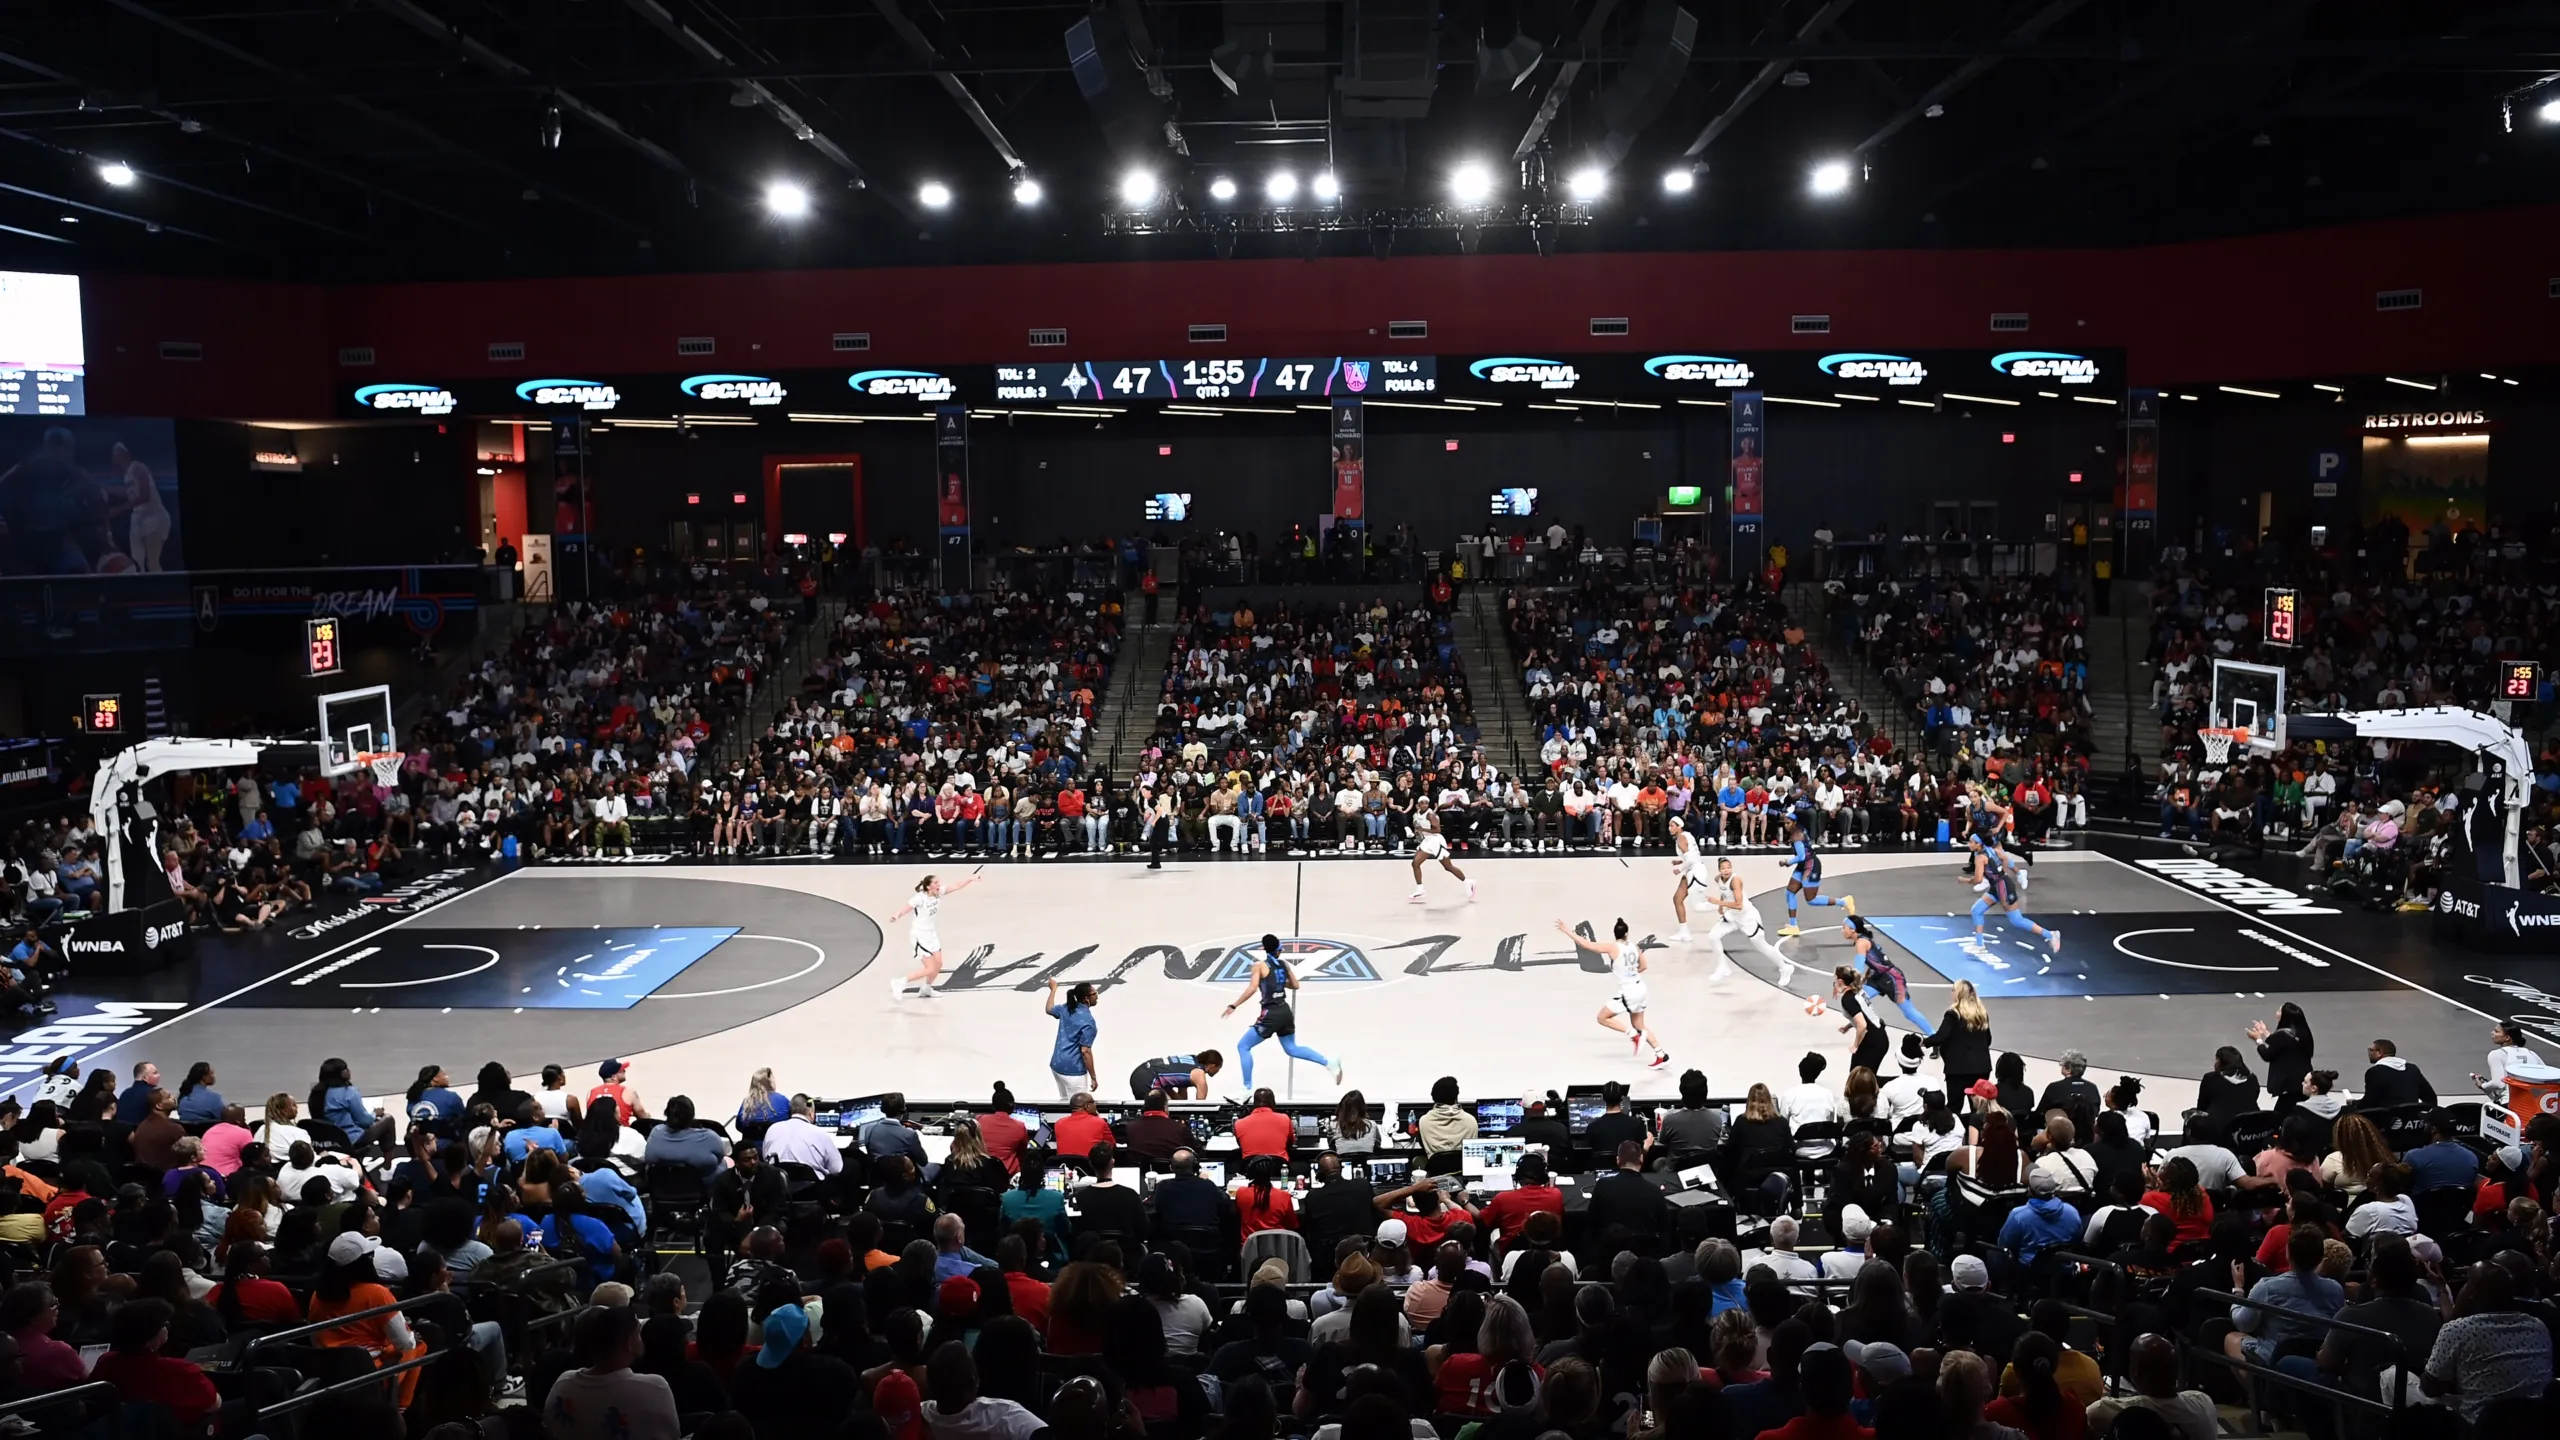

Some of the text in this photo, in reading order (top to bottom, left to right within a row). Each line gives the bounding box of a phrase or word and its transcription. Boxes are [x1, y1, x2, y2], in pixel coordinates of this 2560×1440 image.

[998, 368, 1036, 381] TOL: 2
[1182, 360, 1245, 385] 1:55
[1383, 361, 1418, 373] TOL: 4
[1113, 367, 1151, 394] 47
[1275, 364, 1314, 391] 47
[1426, 379, 1435, 391] 5
[1038, 386, 1047, 398] 3
[1196, 386, 1230, 399] QTR 3
[2365, 411, 2484, 429] RESTROOMS
[2319, 453, 2339, 477] P
[1738, 524, 1756, 532] #12
[948, 536, 961, 545] #7
[233, 586, 312, 597] DO IT FOR THE
[312, 586, 397, 622] DREAM
[2272, 611, 2291, 640] 23
[312, 640, 333, 669] 23
[2513, 667, 2532, 679] 1:55
[2507, 680, 2527, 695] 23
[95, 712, 114, 728] 23
[2, 766, 47, 784] ATLANTA DREAM
[2134, 859, 2343, 915] DREAM
[2454, 899, 2480, 918] AT&T
[2519, 914, 2560, 927] WNB
[160, 921, 184, 942] AT&T
[71, 940, 124, 952] WNBA
[1623, 952, 1637, 966] 10
[1274, 968, 1285, 983] 15
[2486, 1123, 2511, 1139] GATORADE
